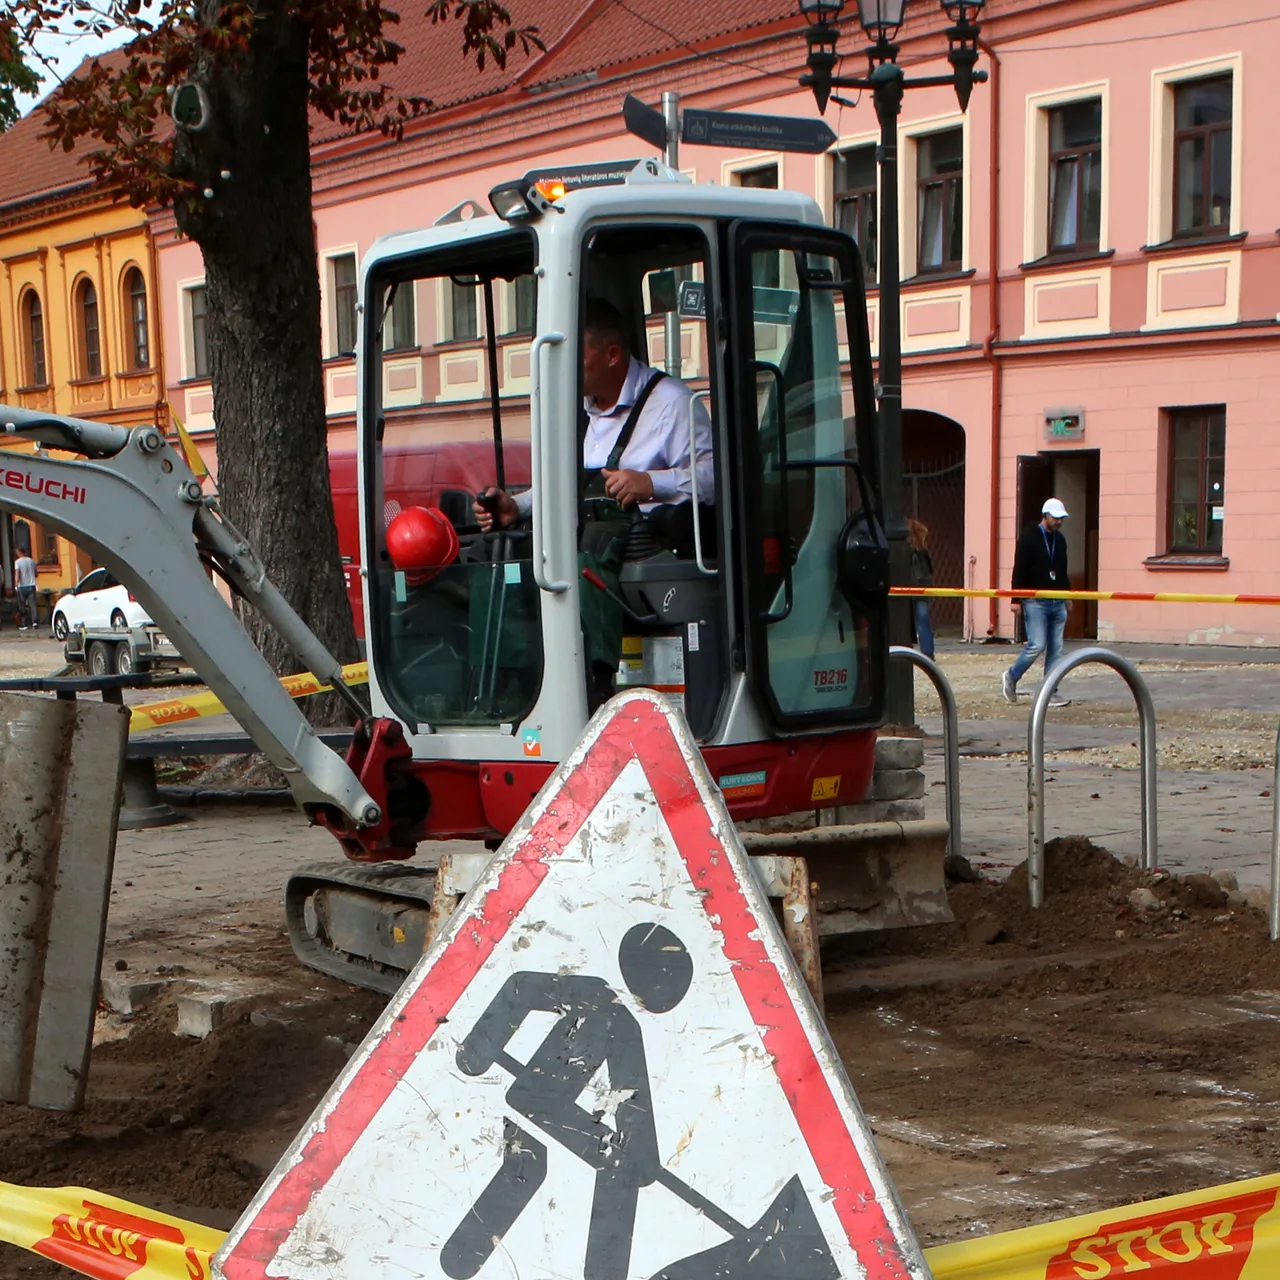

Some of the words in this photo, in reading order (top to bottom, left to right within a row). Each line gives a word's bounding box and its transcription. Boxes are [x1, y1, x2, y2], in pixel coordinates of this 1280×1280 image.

[1052, 419, 1072, 436] WC
[813, 669, 848, 686] TB216
[721, 776, 741, 786] KURT
[1070, 1212, 1237, 1280] STOP
